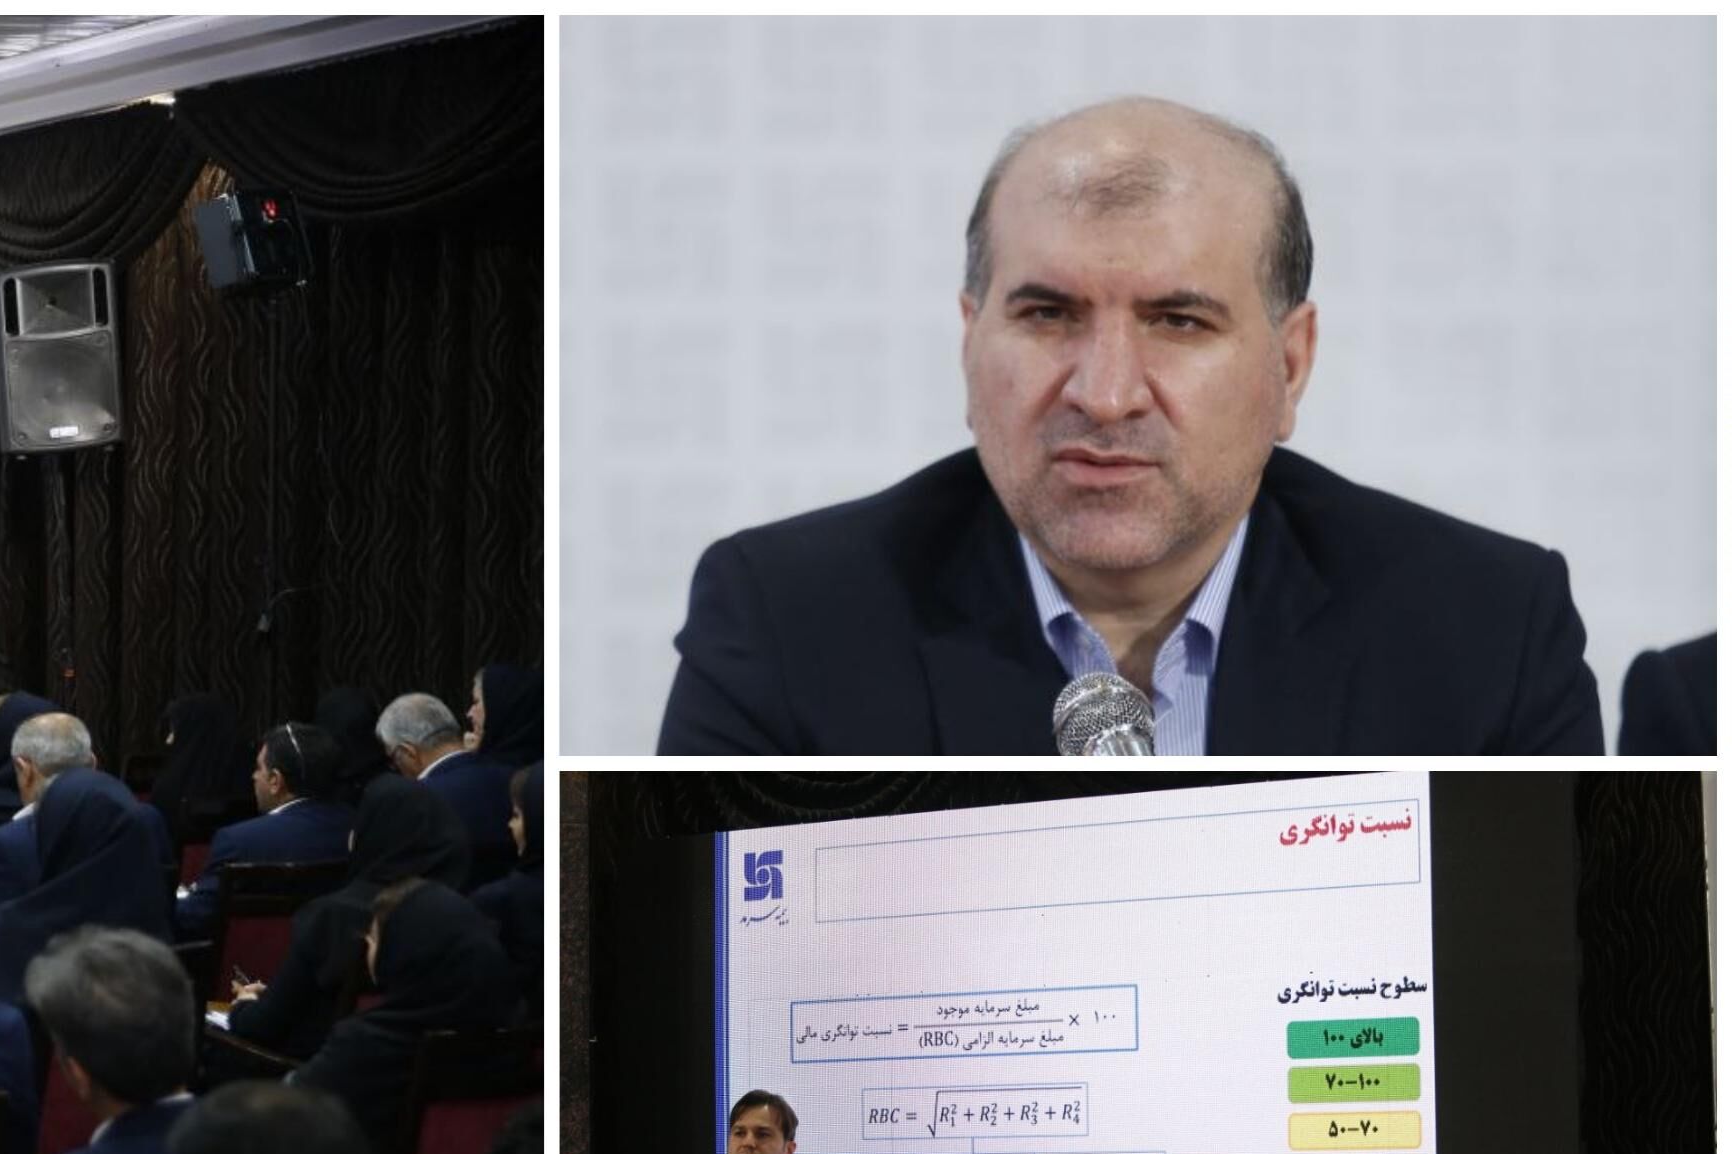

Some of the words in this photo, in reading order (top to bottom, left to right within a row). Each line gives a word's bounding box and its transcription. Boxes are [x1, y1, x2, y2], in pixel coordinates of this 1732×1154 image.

[1279, 813, 1355, 846] توانگری
[1360, 807, 1412, 838] نسبت
[1277, 979, 1335, 1005] توانگری
[1338, 977, 1377, 1000] نسبت
[1379, 975, 1428, 999] سطوح
[935, 1003, 970, 1017] موجود
[973, 999, 1011, 1018] سرمایه
[1014, 1000, 1040, 1018] مبلغ
[795, 1025, 818, 1044] مالی
[820, 1025, 859, 1042] توانگری
[861, 1023, 893, 1038] نسبت
[997, 1030, 1035, 1049] سرمایه
[1038, 1032, 1065, 1048] مبلغ
[1349, 1026, 1385, 1049] بالای
[962, 1033, 994, 1051] الزامی
[868, 1107, 900, 1124] RBC
